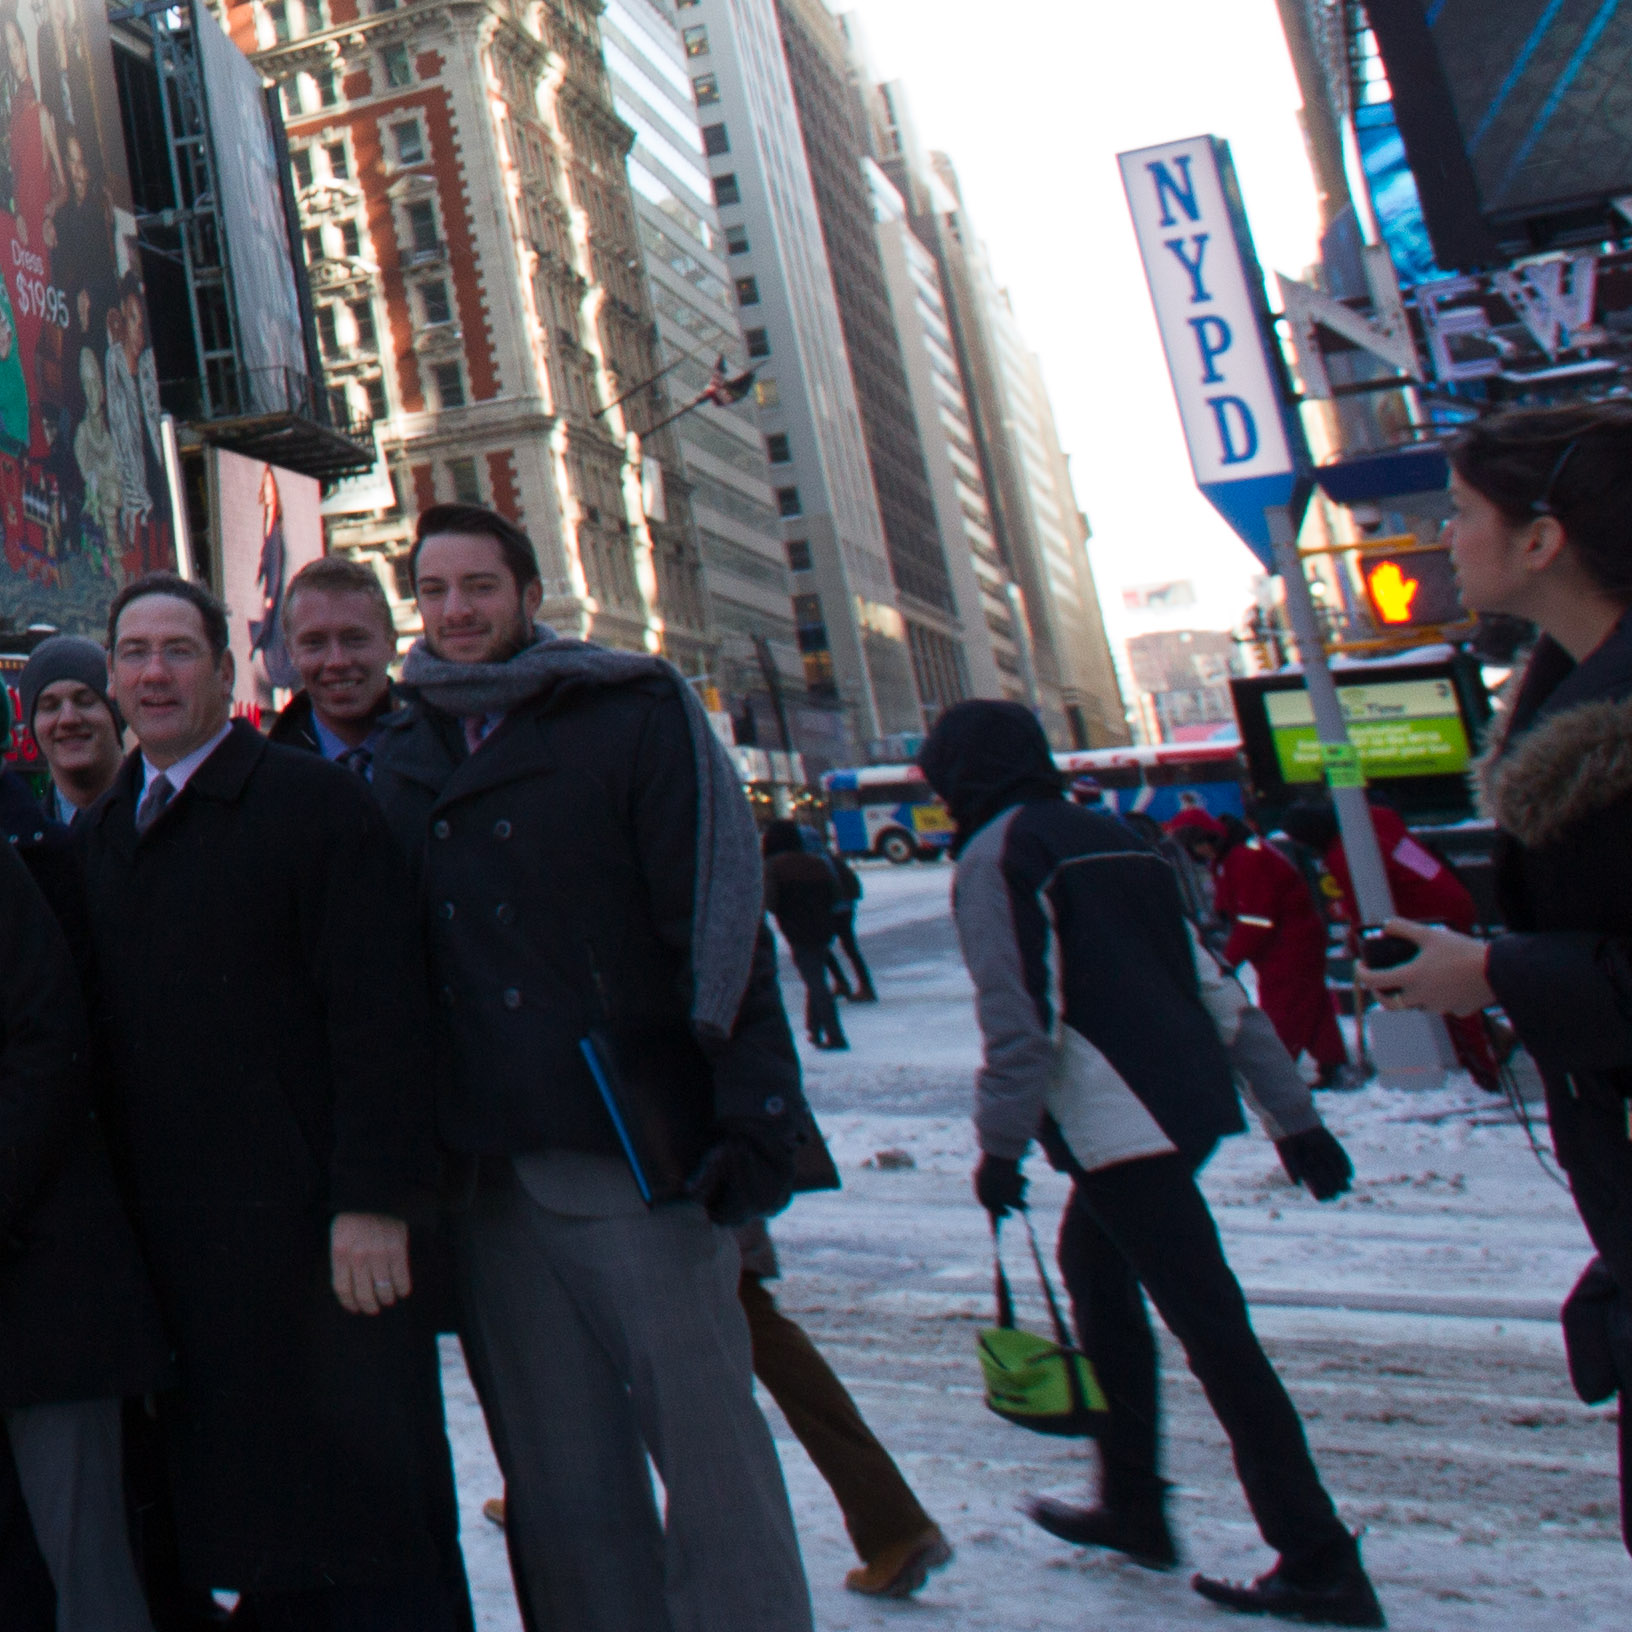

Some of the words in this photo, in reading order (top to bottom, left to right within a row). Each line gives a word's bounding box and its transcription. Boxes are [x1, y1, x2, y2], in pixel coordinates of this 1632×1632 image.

[10, 239, 45, 276] Dress
[16, 270, 70, 329] $19.95
[1146, 154, 1260, 466] NYPD
